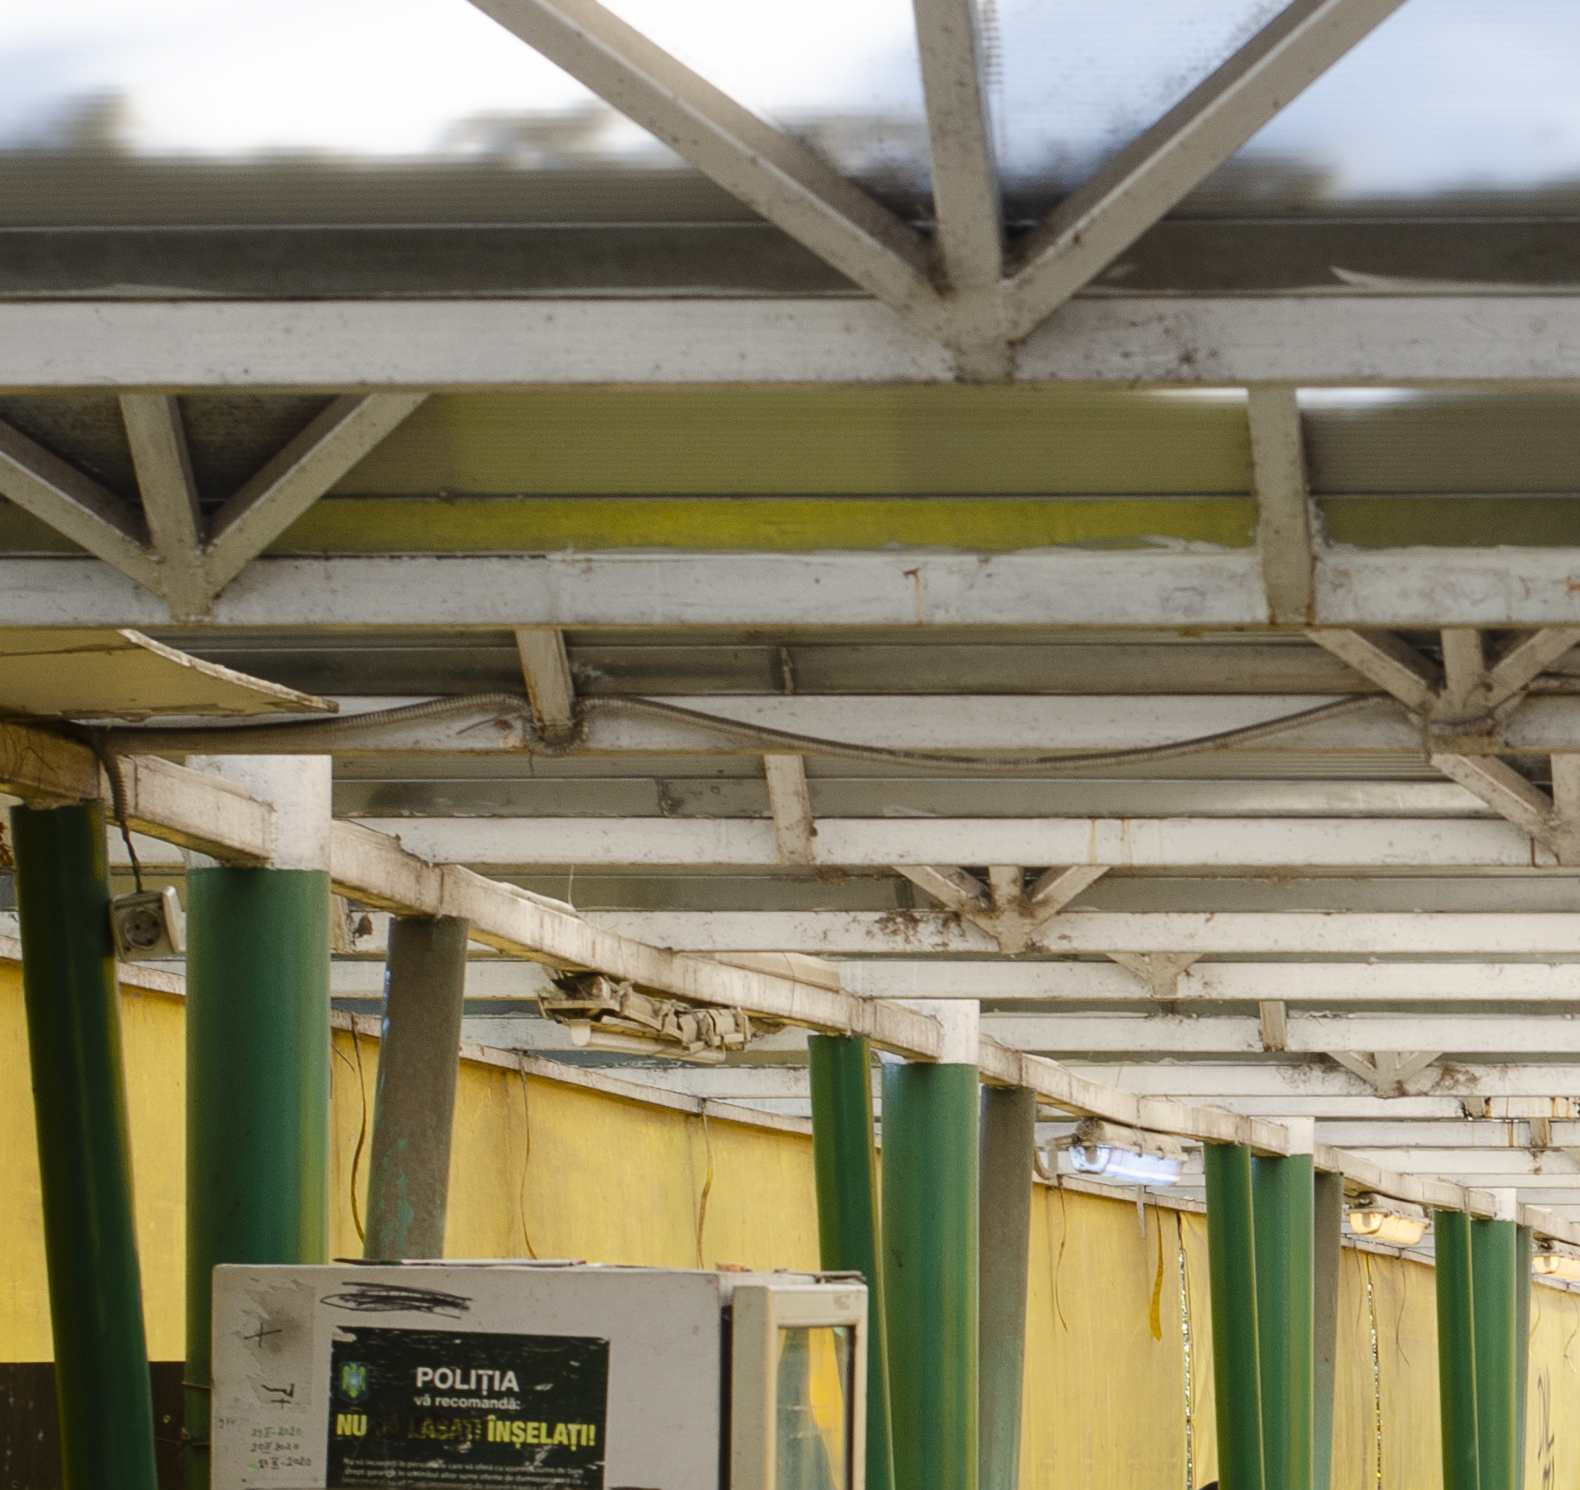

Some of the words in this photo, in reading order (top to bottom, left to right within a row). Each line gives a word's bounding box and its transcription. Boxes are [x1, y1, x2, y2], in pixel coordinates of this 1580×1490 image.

[414, 1395, 432, 1407] vă
[435, 1395, 521, 1411] recomandă:
[336, 1413, 367, 1437] NU
